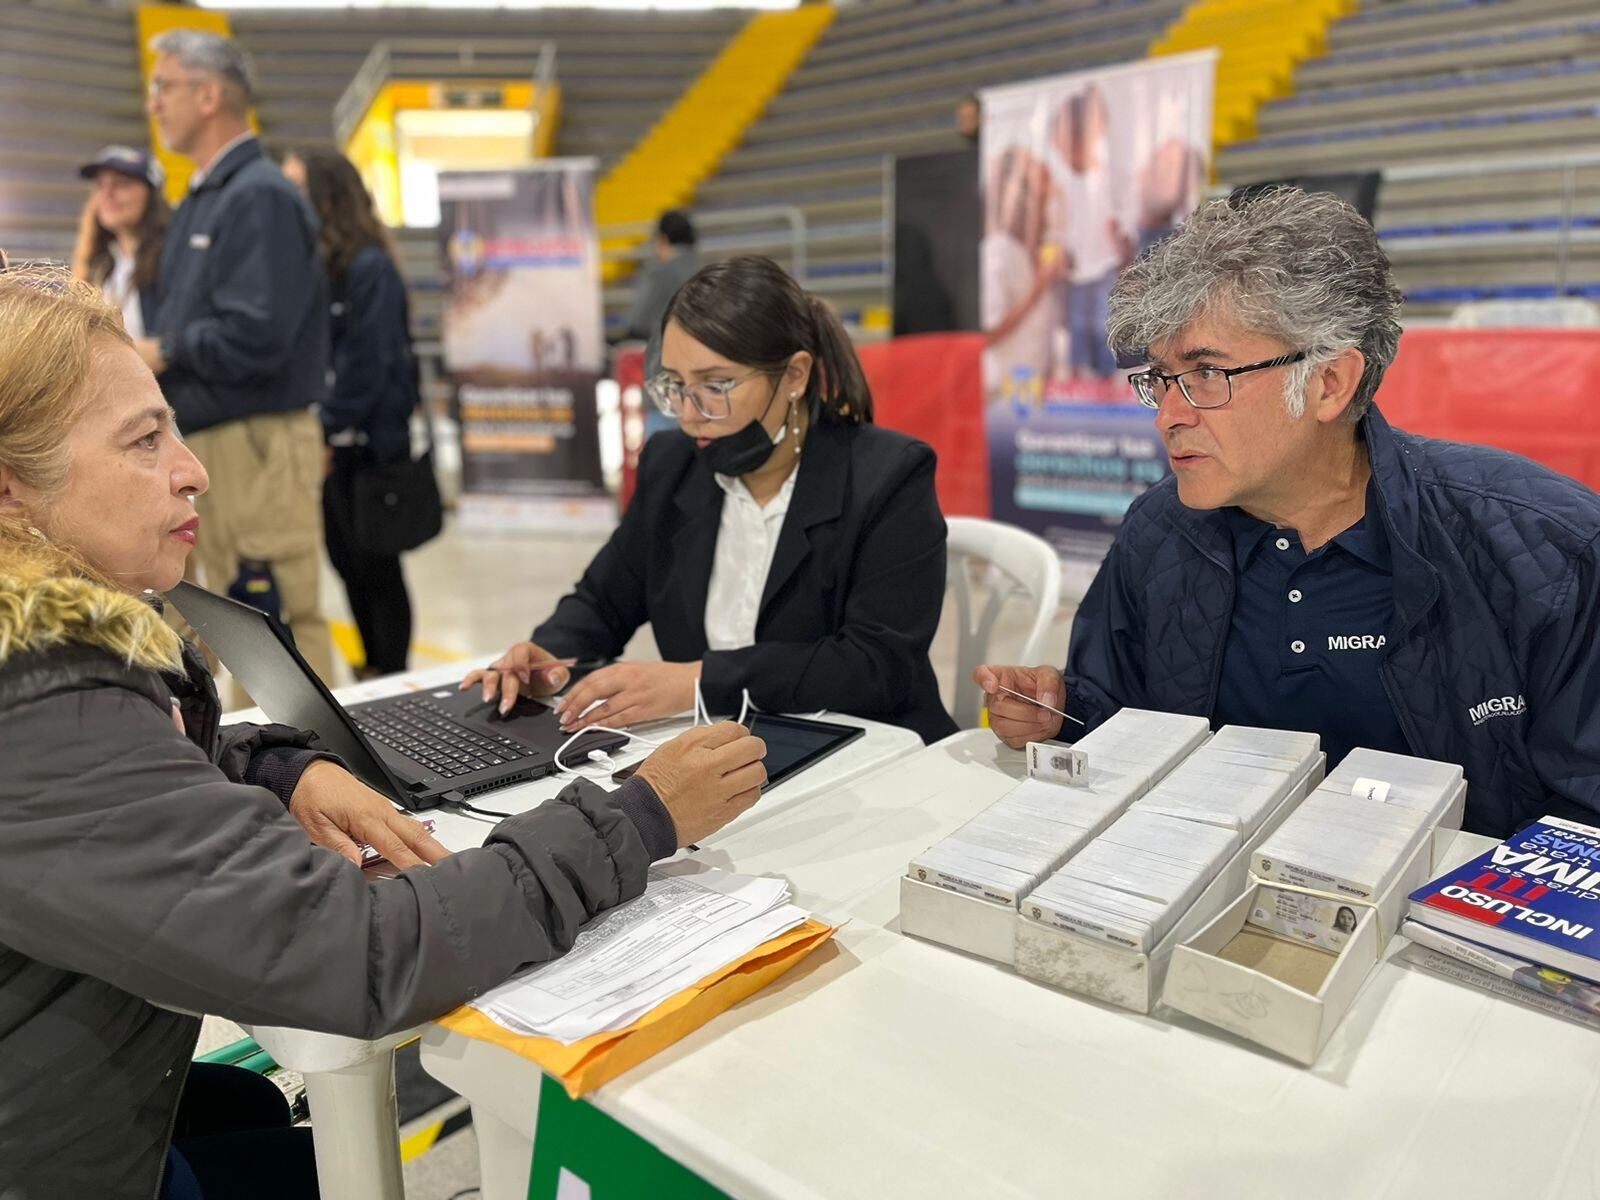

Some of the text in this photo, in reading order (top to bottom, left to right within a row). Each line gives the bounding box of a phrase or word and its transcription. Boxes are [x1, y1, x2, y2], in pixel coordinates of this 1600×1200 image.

[1519, 841, 1591, 868] trata
[1482, 864, 1526, 878] ser
[1440, 885, 1594, 939] INCLUSO
